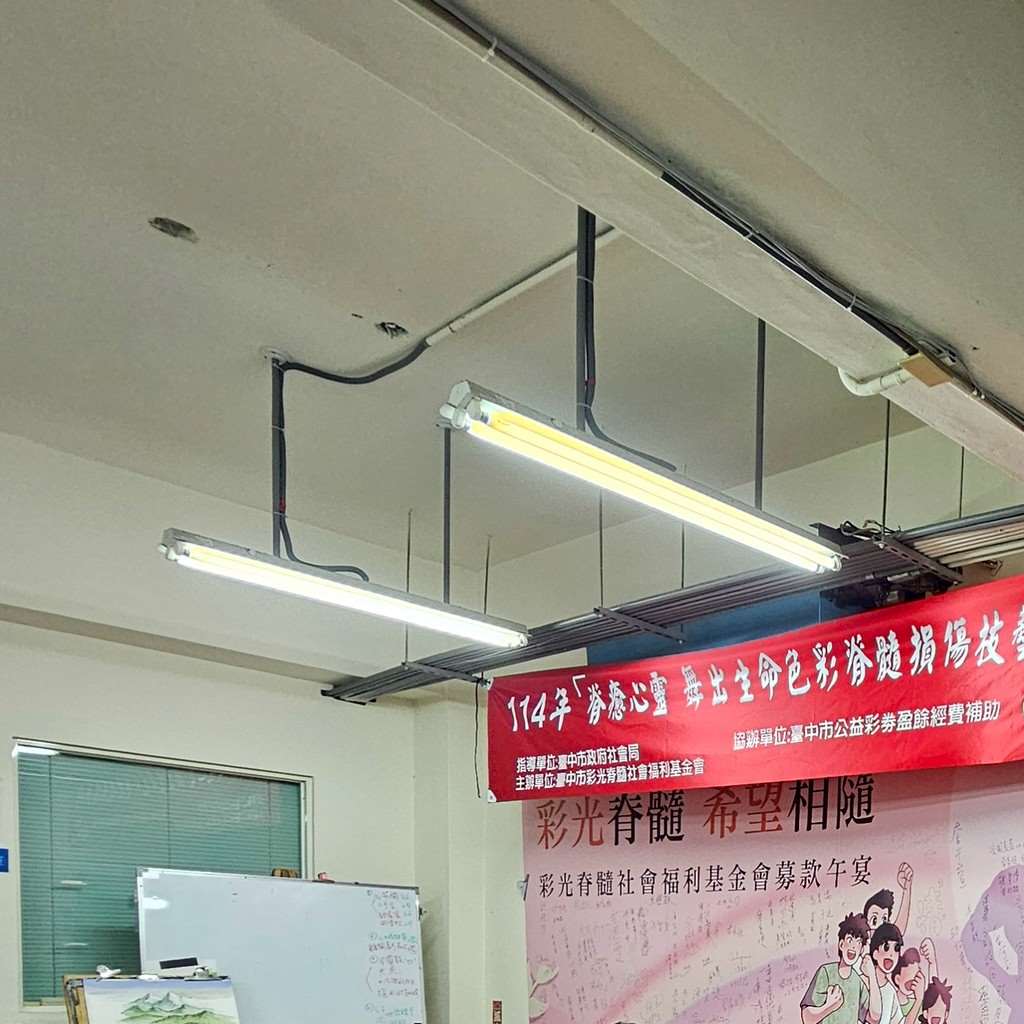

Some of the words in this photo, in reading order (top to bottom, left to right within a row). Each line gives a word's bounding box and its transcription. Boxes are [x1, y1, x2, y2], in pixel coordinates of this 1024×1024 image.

[515, 757, 705, 791] 主辦單位:臺中市彩光脊髓社會福利基金會
[516, 743, 640, 774] 指導單位:臺中市政府社會局
[536, 788, 686, 850] 彩光脊髓
[703, 775, 876, 838] 希望相隨
[539, 854, 873, 899] 彩光脊髓社會福利基金會募款午宴
